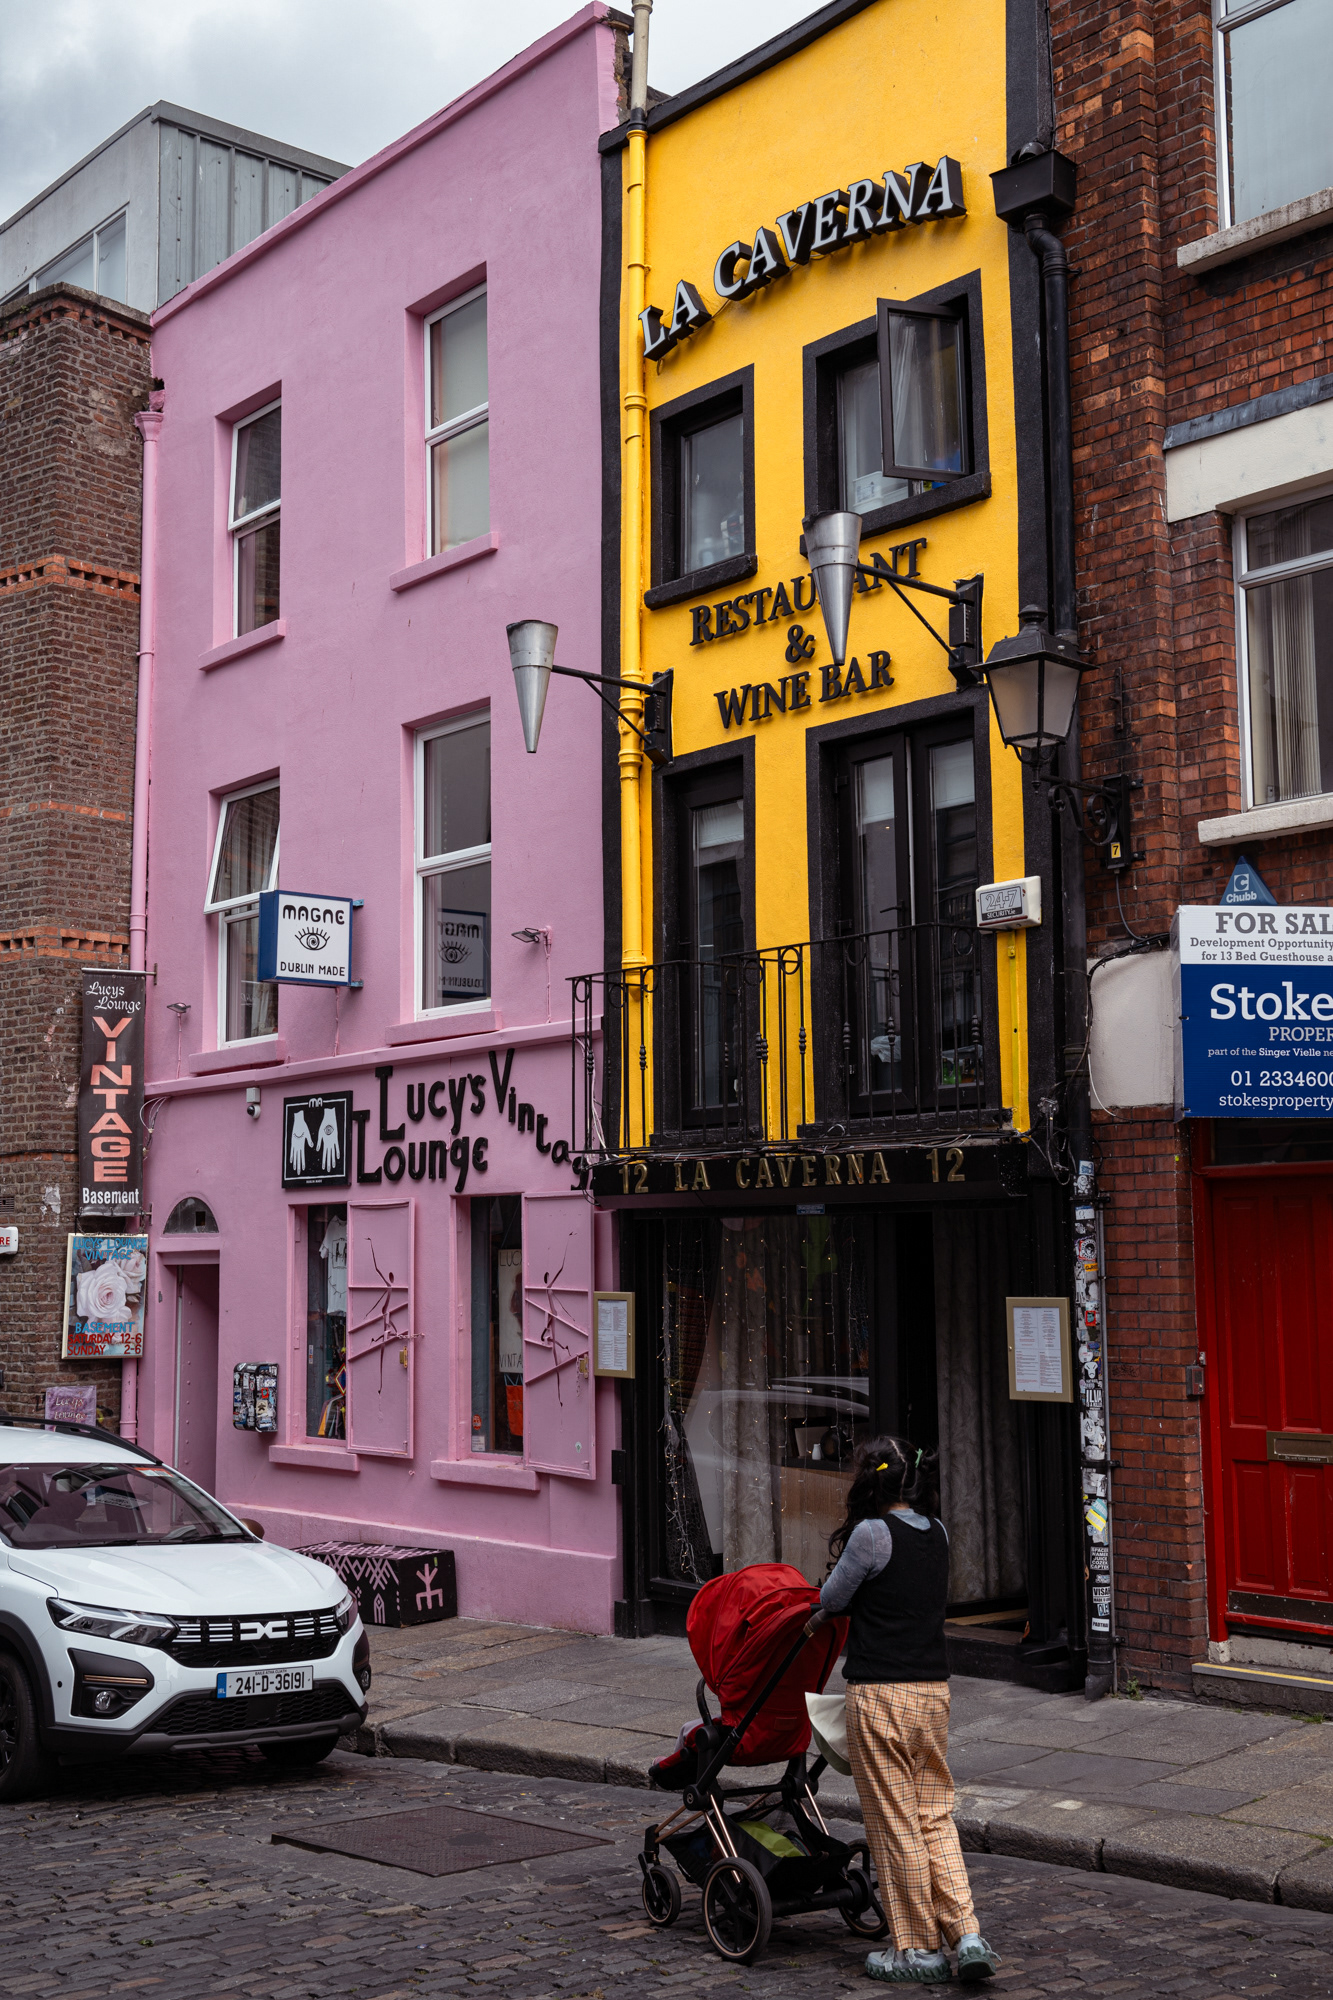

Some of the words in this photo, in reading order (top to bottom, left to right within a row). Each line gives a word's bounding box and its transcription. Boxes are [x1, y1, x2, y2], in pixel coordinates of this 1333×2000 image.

[638, 279, 711, 360] LA
[713, 155, 967, 301] CAVERNA
[689, 537, 927, 646] RESTAUANT
[785, 624, 815, 663] &
[713, 671, 812, 729] WINE
[818, 650, 895, 702] BAR
[1112, 845, 1119, 856] 7
[1226, 891, 1257, 904] Chubb
[986, 908, 1016, 919] SECURITY.ie
[1215, 912, 1279, 934] FOR
[1285, 913, 1333, 935] SAL
[1190, 937, 1265, 950] Development
[1268, 937, 1333, 951] Opportunity
[1201, 951, 1218, 961] for
[1220, 951, 1232, 961] 13
[1235, 951, 1257, 962] Bed
[1259, 951, 1325, 962] Guesthouse
[280, 961, 314, 974] DUBLIN
[318, 964, 346, 977] MADE
[85, 981, 125, 999] Lucys
[94, 996, 142, 1014] Lounge
[1210, 981, 1333, 1021] Stoke
[1208, 1047, 1228, 1057] part
[1230, 1047, 1240, 1056] of
[1241, 1047, 1257, 1056] the
[1259, 1047, 1290, 1058] Singer
[1293, 1048, 1321, 1057] Vielle
[1230, 1070, 1252, 1087] 01
[88, 1016, 133, 1182] VINTAGE
[1219, 1093, 1333, 1111] stokesproperty
[352, 1109, 489, 1193] Lounge
[618, 1163, 648, 1194] 12
[674, 1161, 711, 1191] LA
[735, 1151, 891, 1189] CAVERNA
[925, 1147, 966, 1183] 12
[82, 1187, 140, 1205] Basement
[73, 1237, 102, 1250] LUCYS
[107, 1237, 147, 1250] LOUNGE
[85, 1250, 133, 1261] VINTAGE
[75, 1321, 136, 1334] BASEMENT
[67, 1333, 115, 1345] SATURDAY
[120, 1333, 142, 1344] 12-6
[67, 1345, 106, 1356] SUNDAY
[124, 1345, 141, 1355] 2-6
[235, 1672, 305, 1694] 241-D-36191
